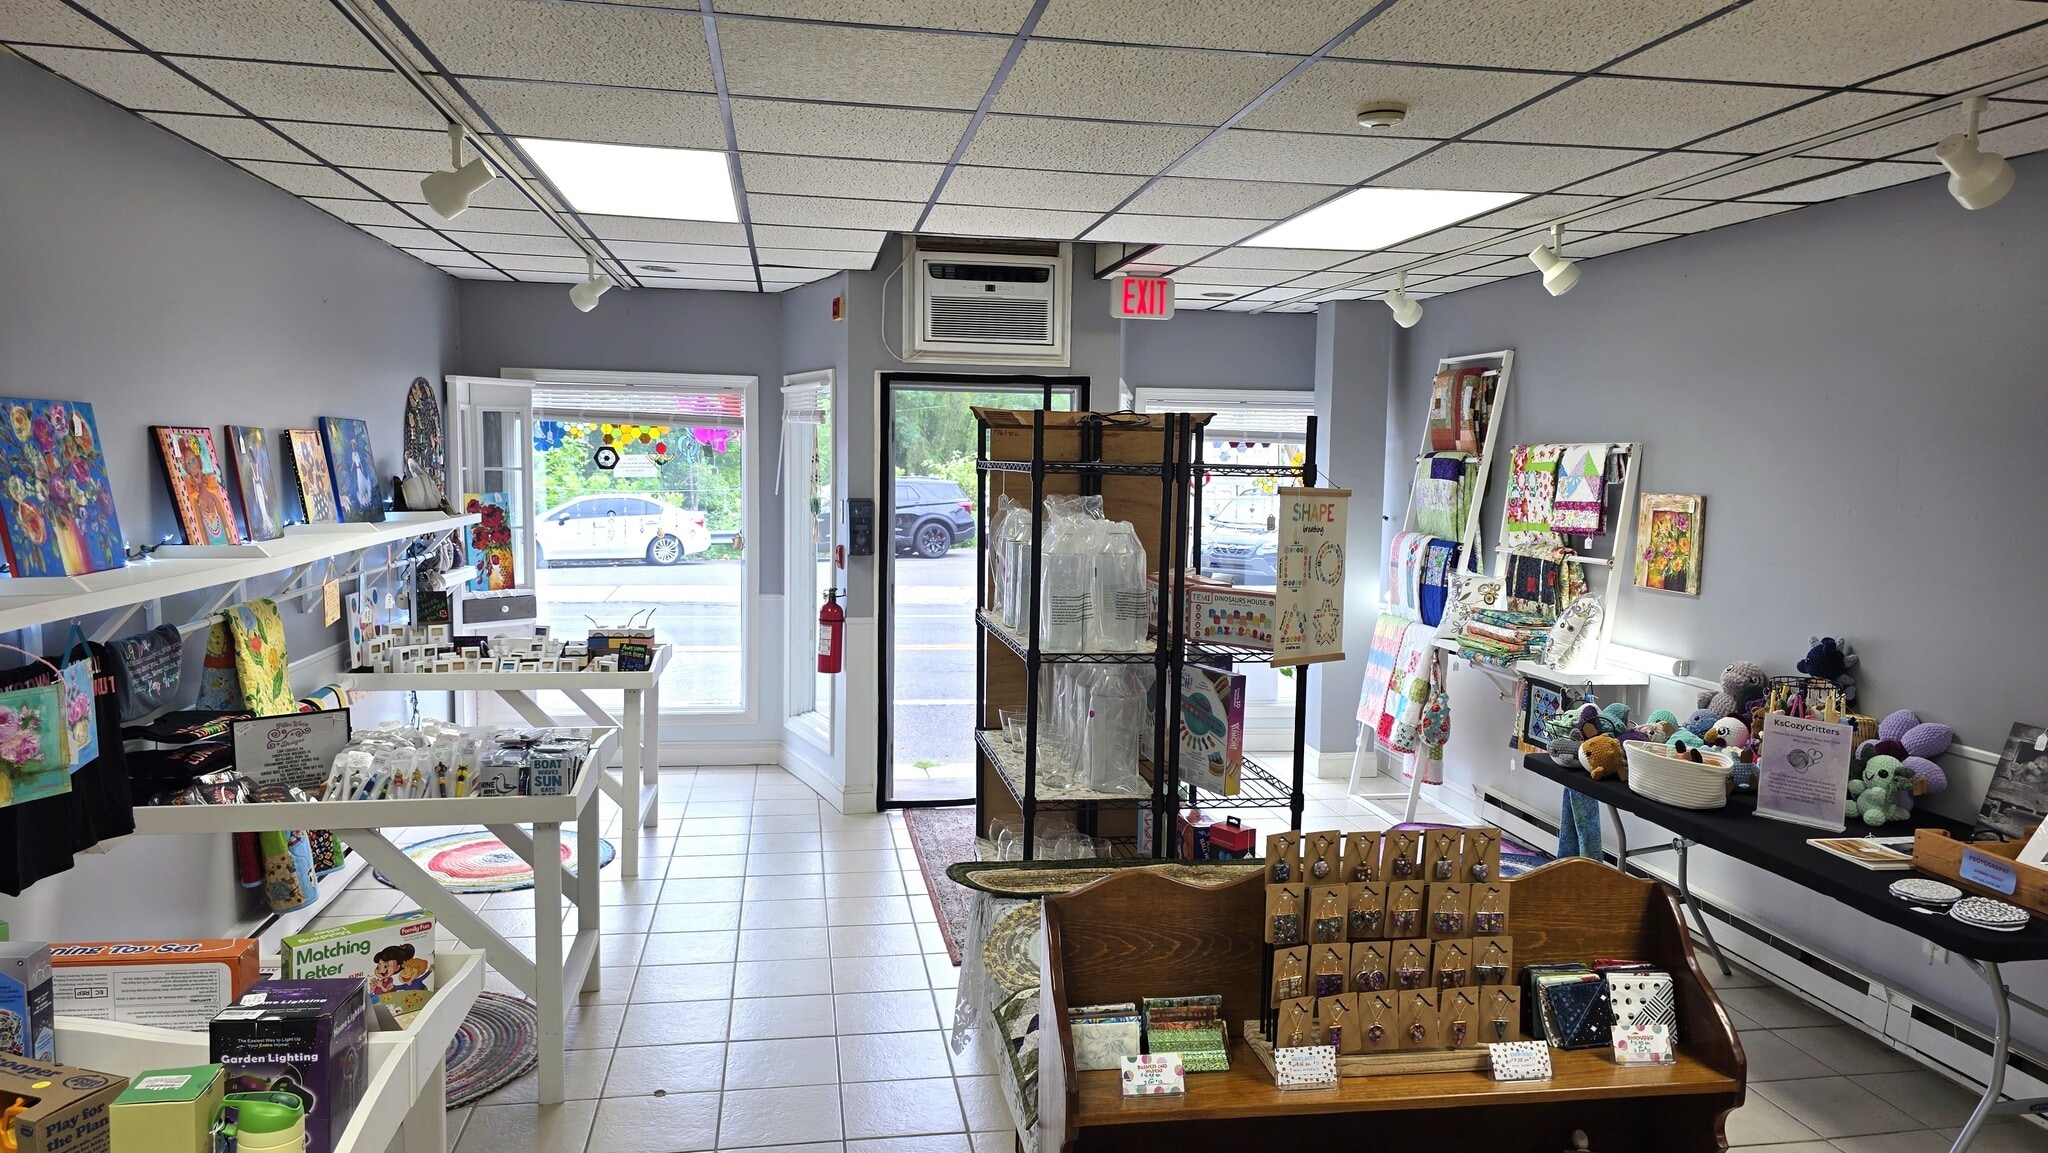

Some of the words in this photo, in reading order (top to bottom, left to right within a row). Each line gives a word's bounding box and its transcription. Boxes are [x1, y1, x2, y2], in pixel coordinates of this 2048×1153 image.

[1122, 278, 1168, 315] EXIT
[1292, 502, 1335, 522] SHAPE
[1192, 593, 1211, 602] TEMI
[1214, 595, 1246, 604] DINOSAURS
[1773, 719, 1840, 736] KsCozyCritters
[533, 759, 563, 769] BOAT
[534, 775, 562, 787] SUN
[400, 924, 420, 936] Family
[419, 923, 431, 931] Fun
[50, 945, 106, 955] ning
[108, 944, 152, 954] Toy
[157, 943, 201, 953] Set
[296, 940, 371, 965] Matching
[296, 963, 344, 980] Letter
[221, 1054, 265, 1065] Garden
[268, 1052, 319, 1063] Lighting
[45, 1115, 80, 1138] Play
[82, 1102, 105, 1121] for
[46, 1134, 73, 1152] the
